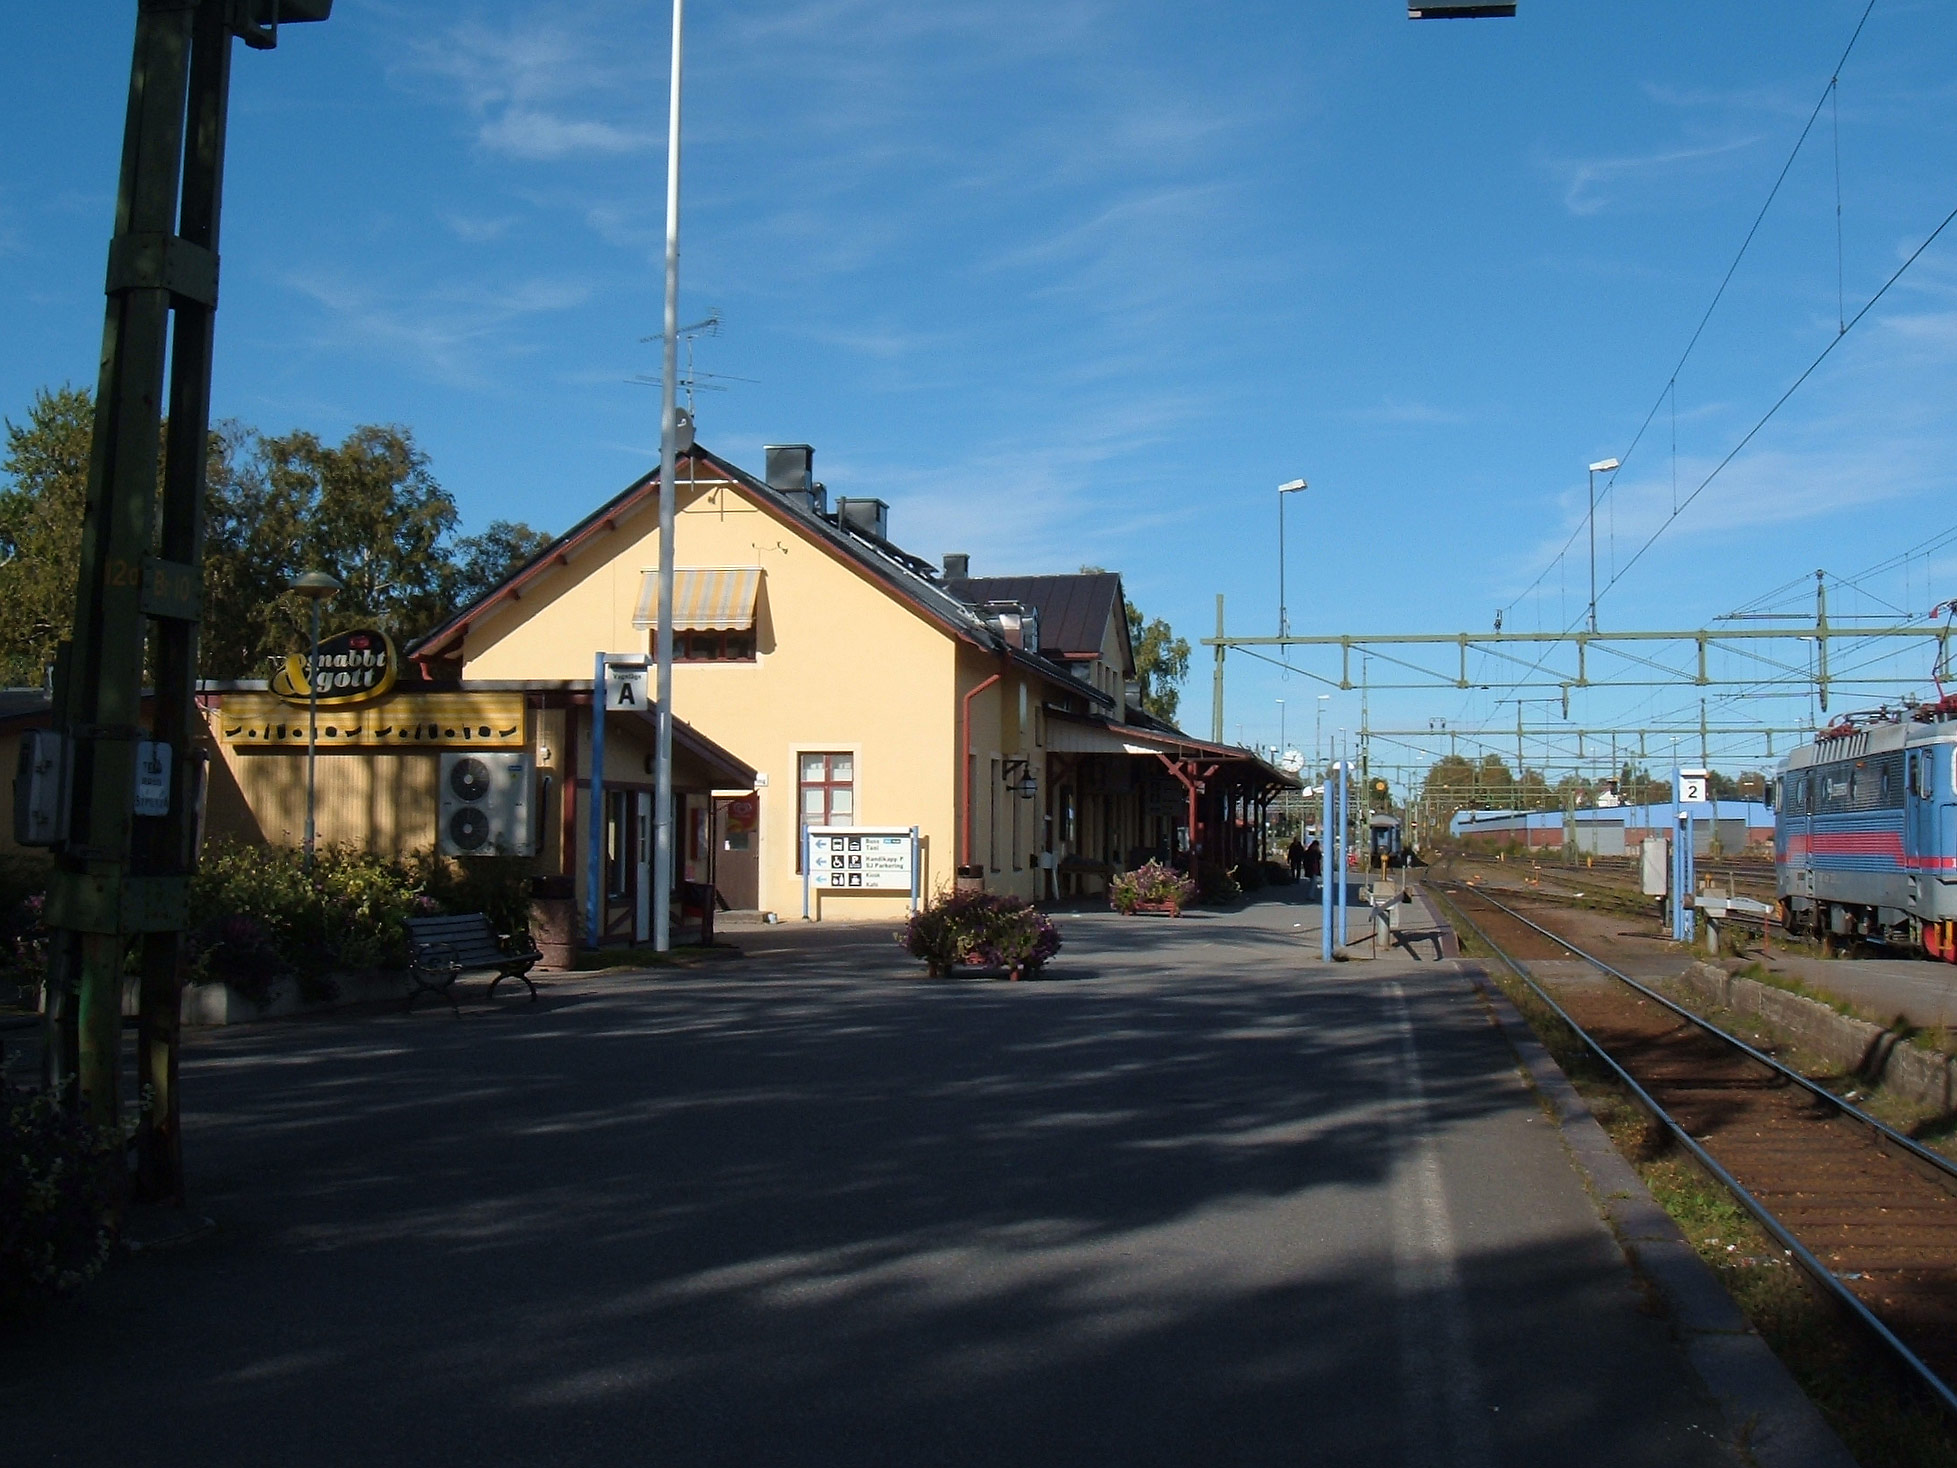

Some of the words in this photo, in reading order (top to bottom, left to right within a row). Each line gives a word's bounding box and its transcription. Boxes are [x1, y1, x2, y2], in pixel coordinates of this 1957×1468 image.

[316, 668, 377, 693] gott
[618, 682, 635, 705] A
[1688, 785, 1698, 799] 2
